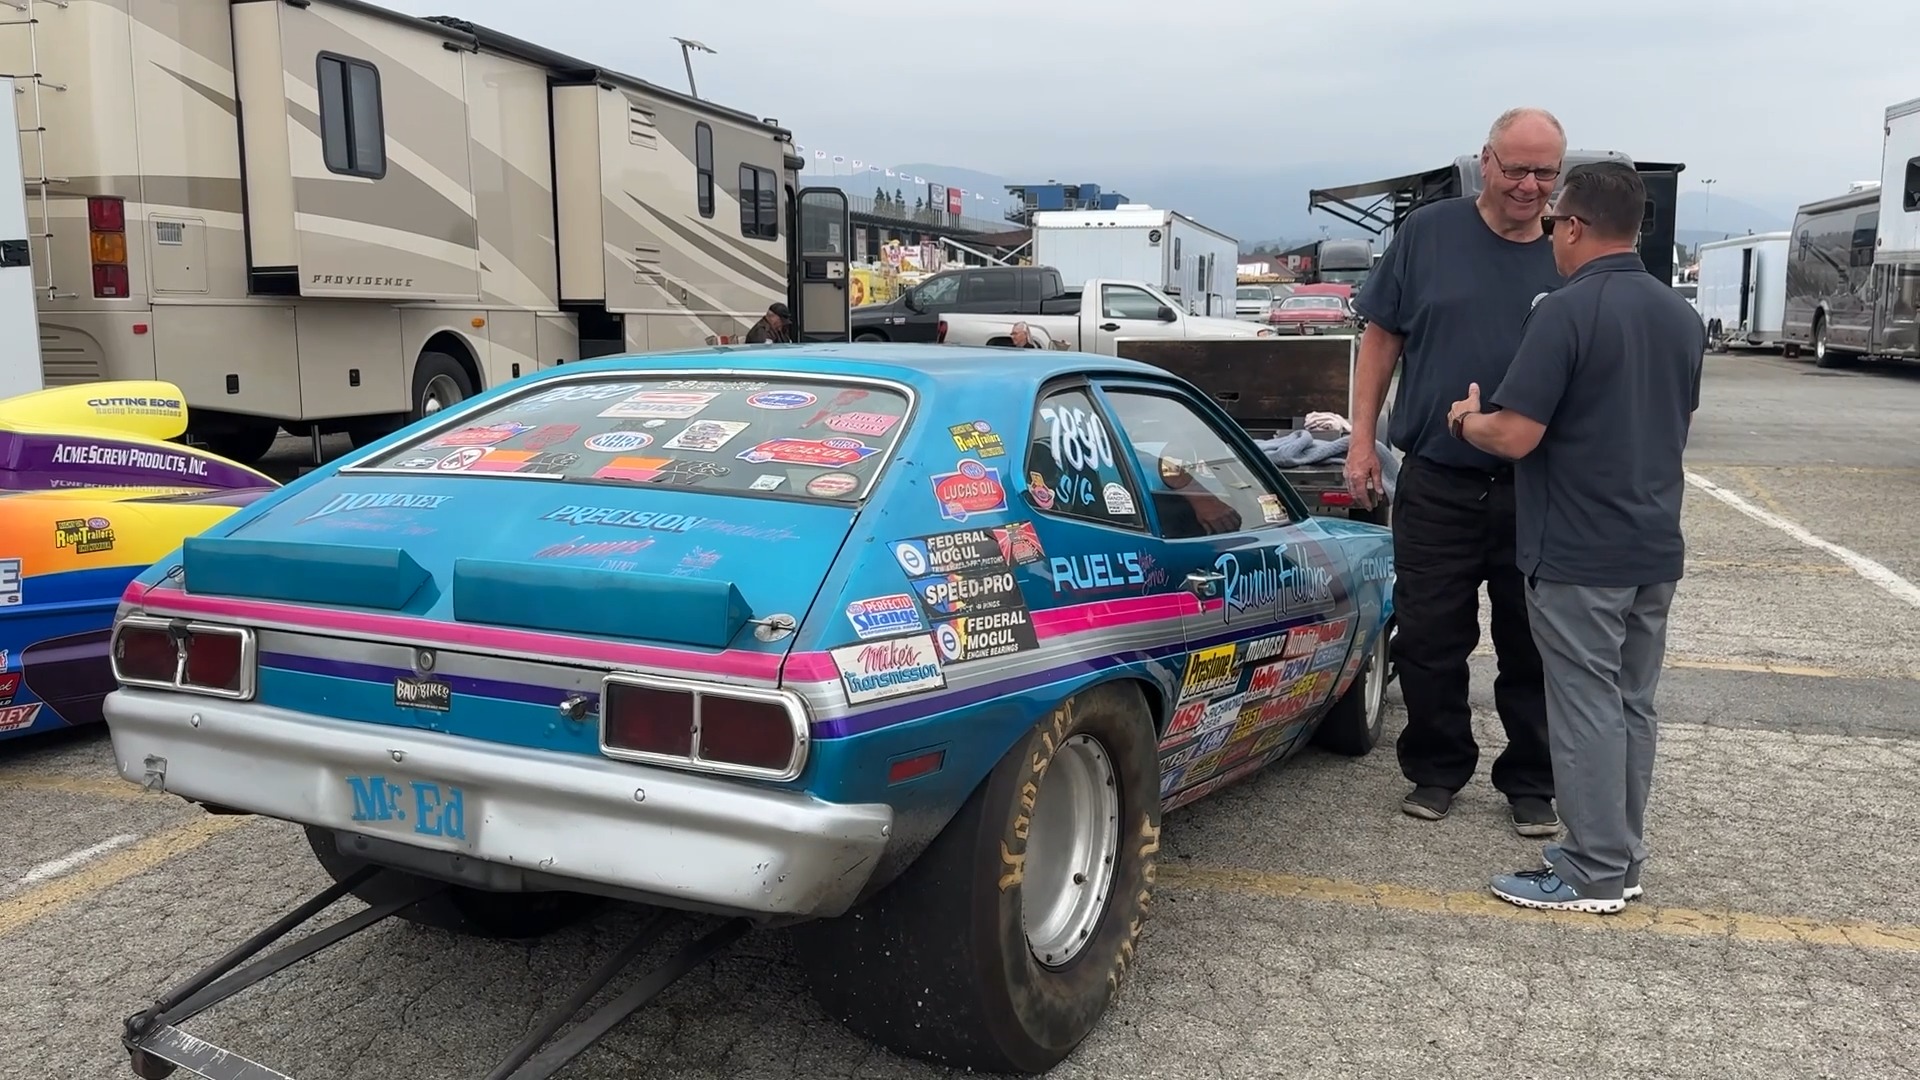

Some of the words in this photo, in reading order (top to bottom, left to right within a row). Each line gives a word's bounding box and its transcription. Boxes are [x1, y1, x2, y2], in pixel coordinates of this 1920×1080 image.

[312, 274, 414, 287] PROVIDENCE
[87, 397, 147, 407] CUTTING
[149, 398, 180, 408] EDGE
[597, 432, 645, 449] NHRA
[828, 438, 858, 448] NHRA
[1040, 405, 1114, 472] 7890
[52, 444, 89, 464] ACME
[88, 445, 130, 466] SCREW
[128, 449, 187, 475] PRODUCTS,
[188, 457, 209, 476] INC.
[762, 443, 822, 455] LUCAS
[823, 449, 850, 459] OIL
[943, 482, 979, 500] LUCAS
[979, 480, 997, 495] OIL
[295, 492, 454, 525] DOWNEY
[542, 504, 704, 533] PRECISION
[927, 530, 989, 549] FEDERAL
[929, 545, 981, 566] MOGUL
[1050, 552, 1144, 592] RUEL'S
[926, 572, 1014, 605] SPEED-PRO
[852, 608, 918, 633] Strange
[967, 610, 1026, 633] FEDERAL
[967, 629, 1016, 651] MOGUL
[967, 649, 989, 660] ENGINE
[990, 644, 1019, 656] BEARINGS
[1186, 652, 1232, 686] Prestone
[396, 678, 417, 701] BAD
[419, 682, 450, 699] BIKES
[1169, 702, 1206, 735] MSD
[345, 775, 406, 821] Mr.
[409, 780, 466, 840] Ed
